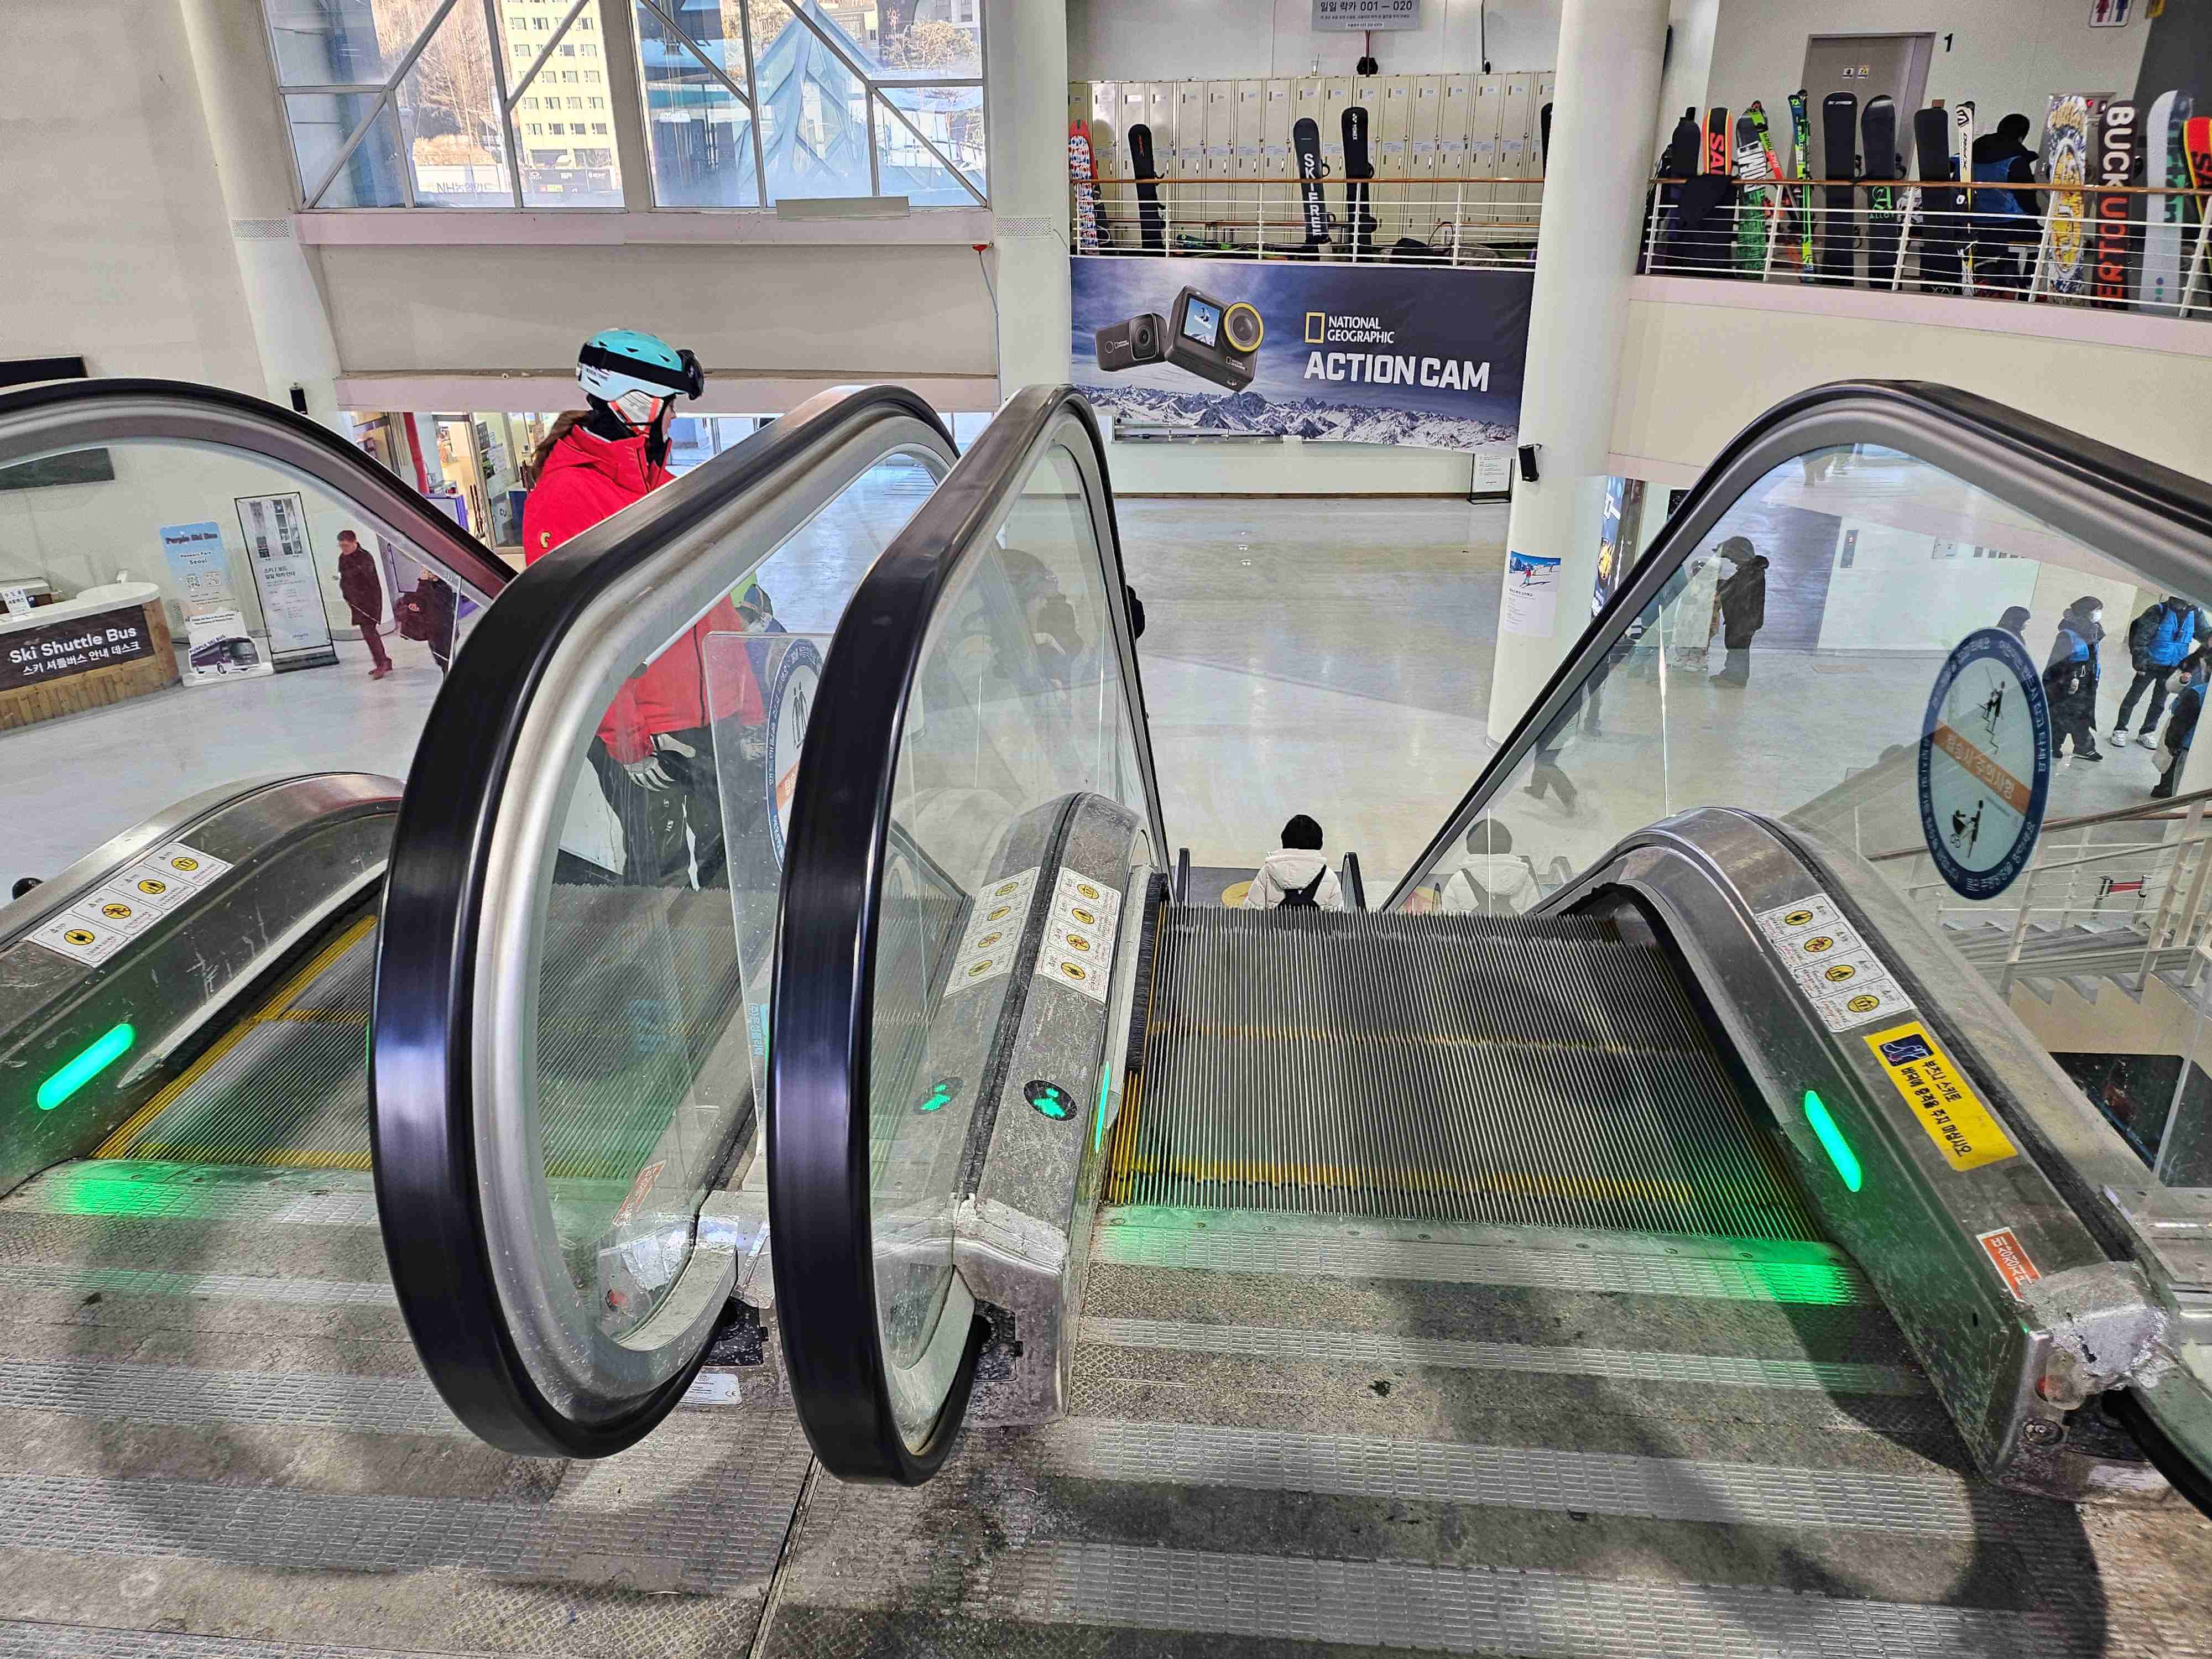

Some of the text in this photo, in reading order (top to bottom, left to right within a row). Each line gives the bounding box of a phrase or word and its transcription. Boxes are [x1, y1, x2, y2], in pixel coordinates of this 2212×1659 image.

[1320, 2, 1337, 12] 일일
[1360, 1, 1378, 11] 001
[1393, 1, 1412, 11] 020
[1944, 33, 1954, 52] 1
[2102, 106, 2135, 186] BUCK
[1327, 330, 1395, 343] GEOGRAPHIC
[1328, 315, 1381, 330] NATIONAL
[1304, 351, 1490, 392] ACTION CAM
[9, 628, 137, 664] Ski Shuttle Bus
[23, 640, 141, 676] 스키 셔틀버스 안내 데스크
[2038, 732, 2047, 773] 타세요
[1901, 1066, 1925, 1088] 바닥에
[1930, 1109, 1952, 1125] 주지
[1936, 1082, 1963, 1102] 스키로
